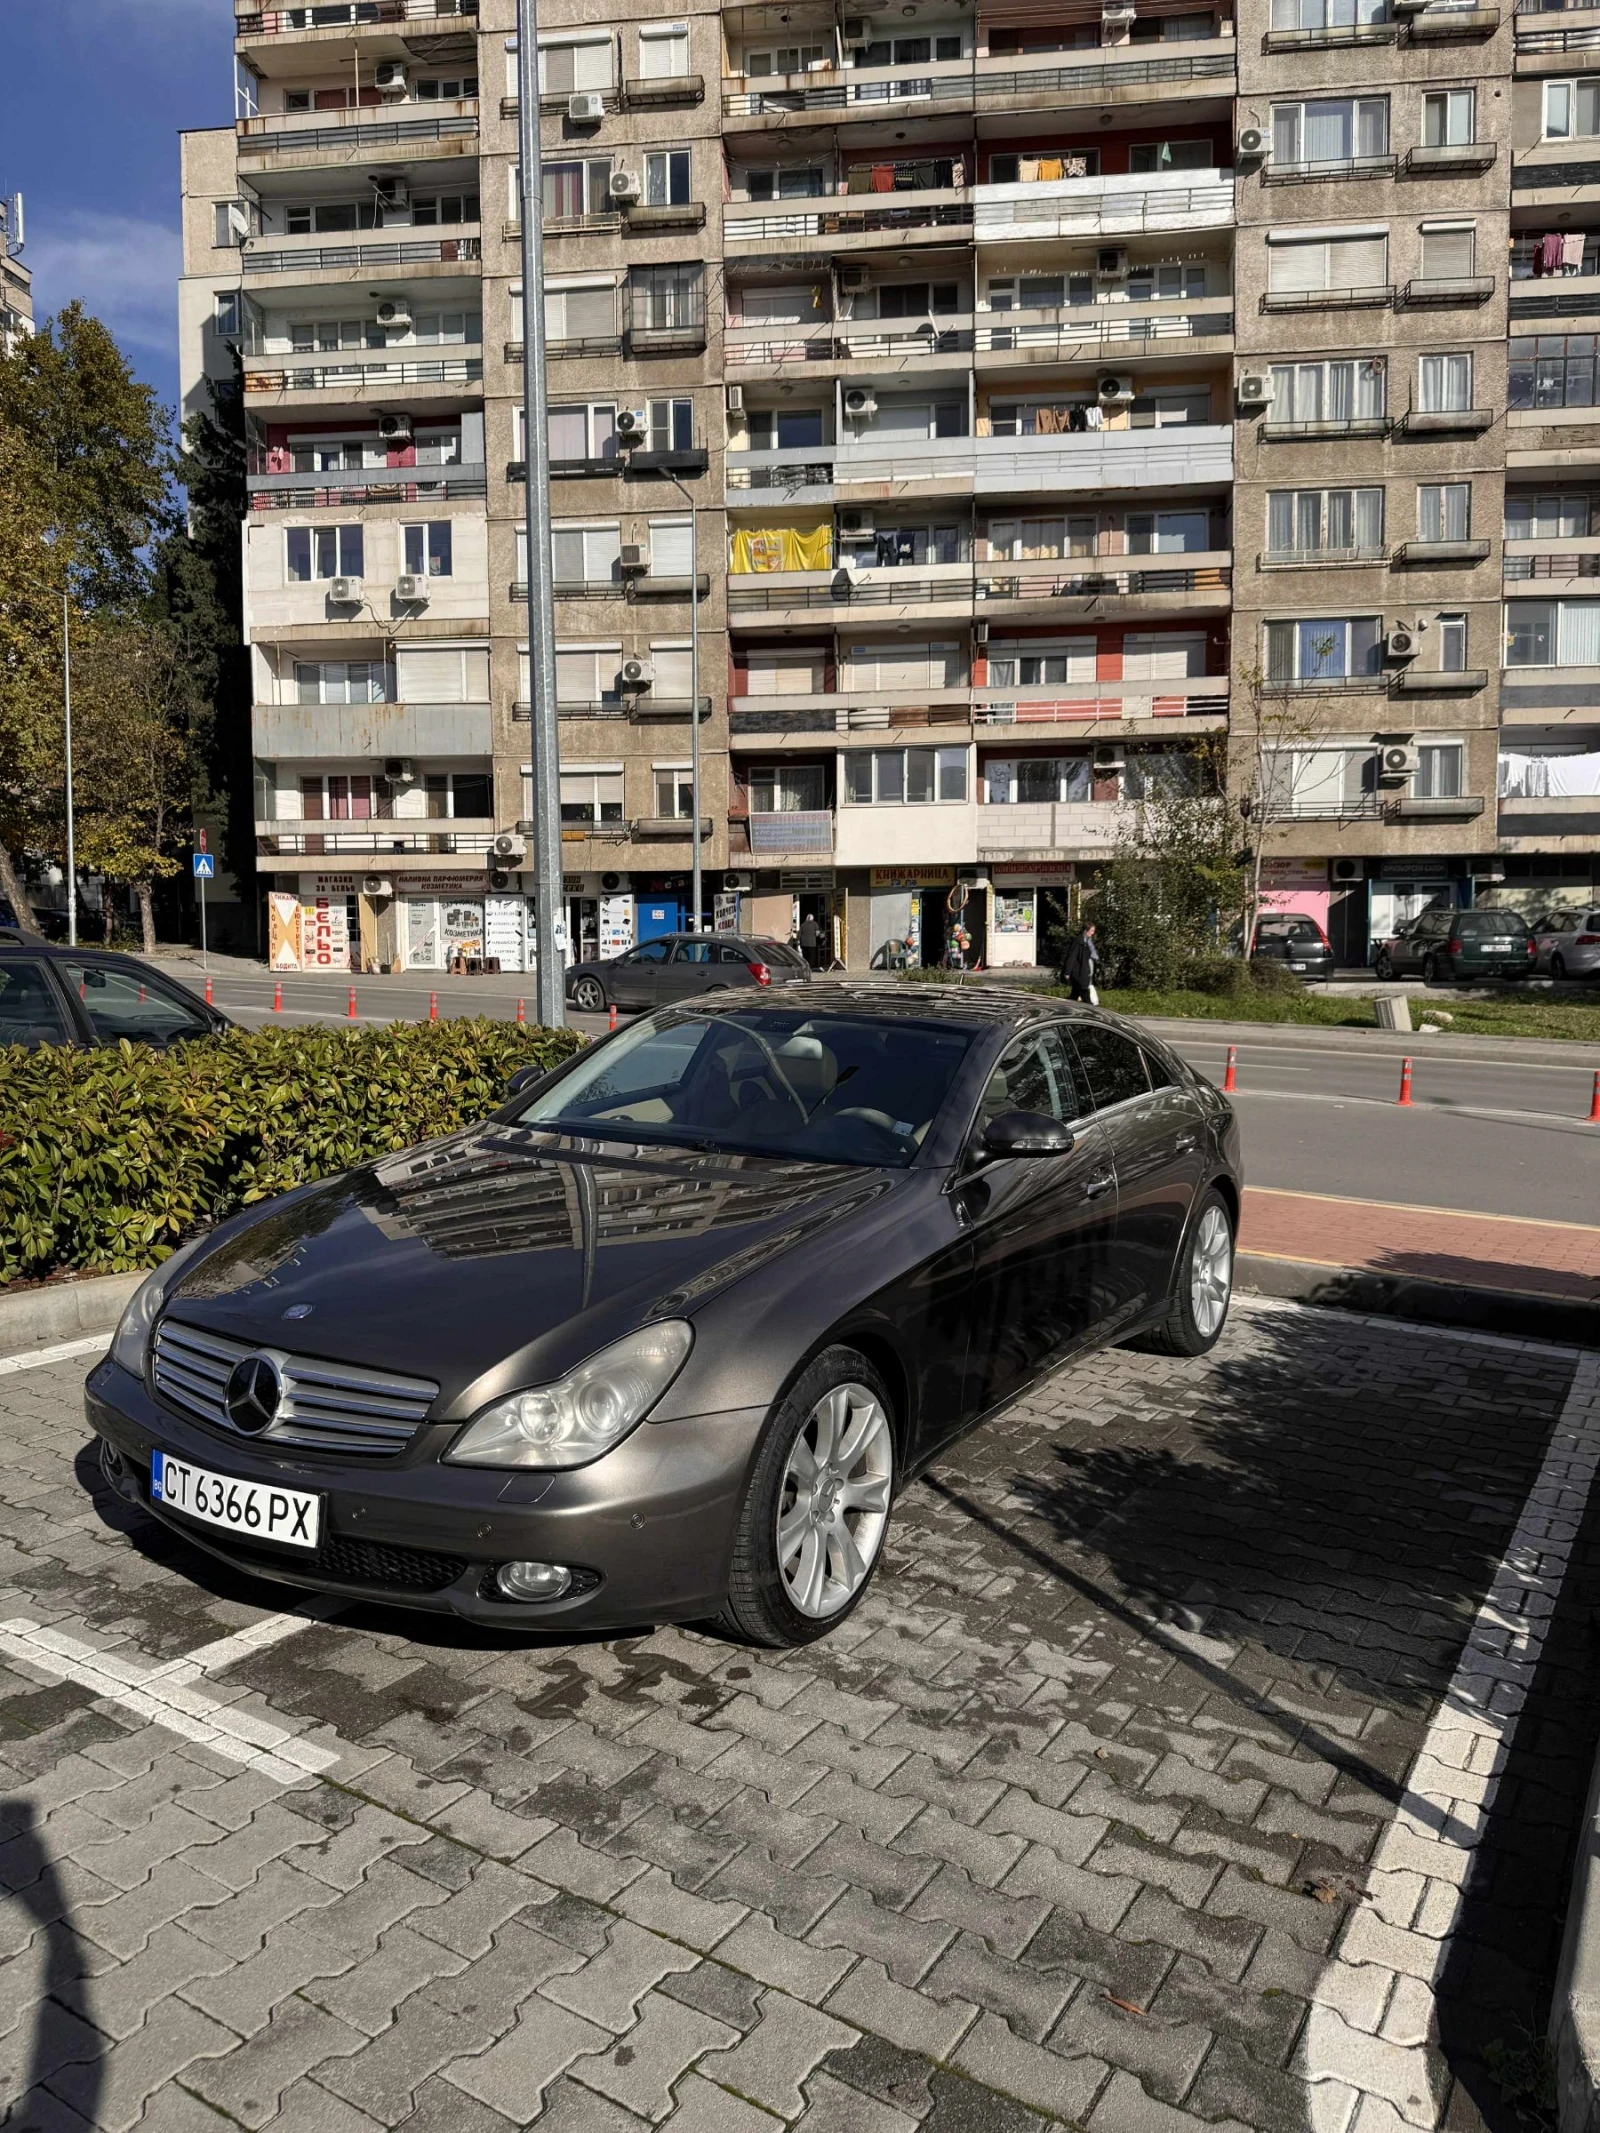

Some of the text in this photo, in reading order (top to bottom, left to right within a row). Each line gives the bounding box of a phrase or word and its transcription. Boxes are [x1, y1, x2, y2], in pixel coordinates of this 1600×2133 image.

[433, 875, 484, 883] ПАРФЮМЕРИЯ
[875, 868, 949, 879] КНИЖАРНИЦА
[444, 928, 483, 938] КОЗМЕТИКА
[153, 1479, 163, 1493] BG
[165, 1461, 312, 1541] CT 6366 PX
